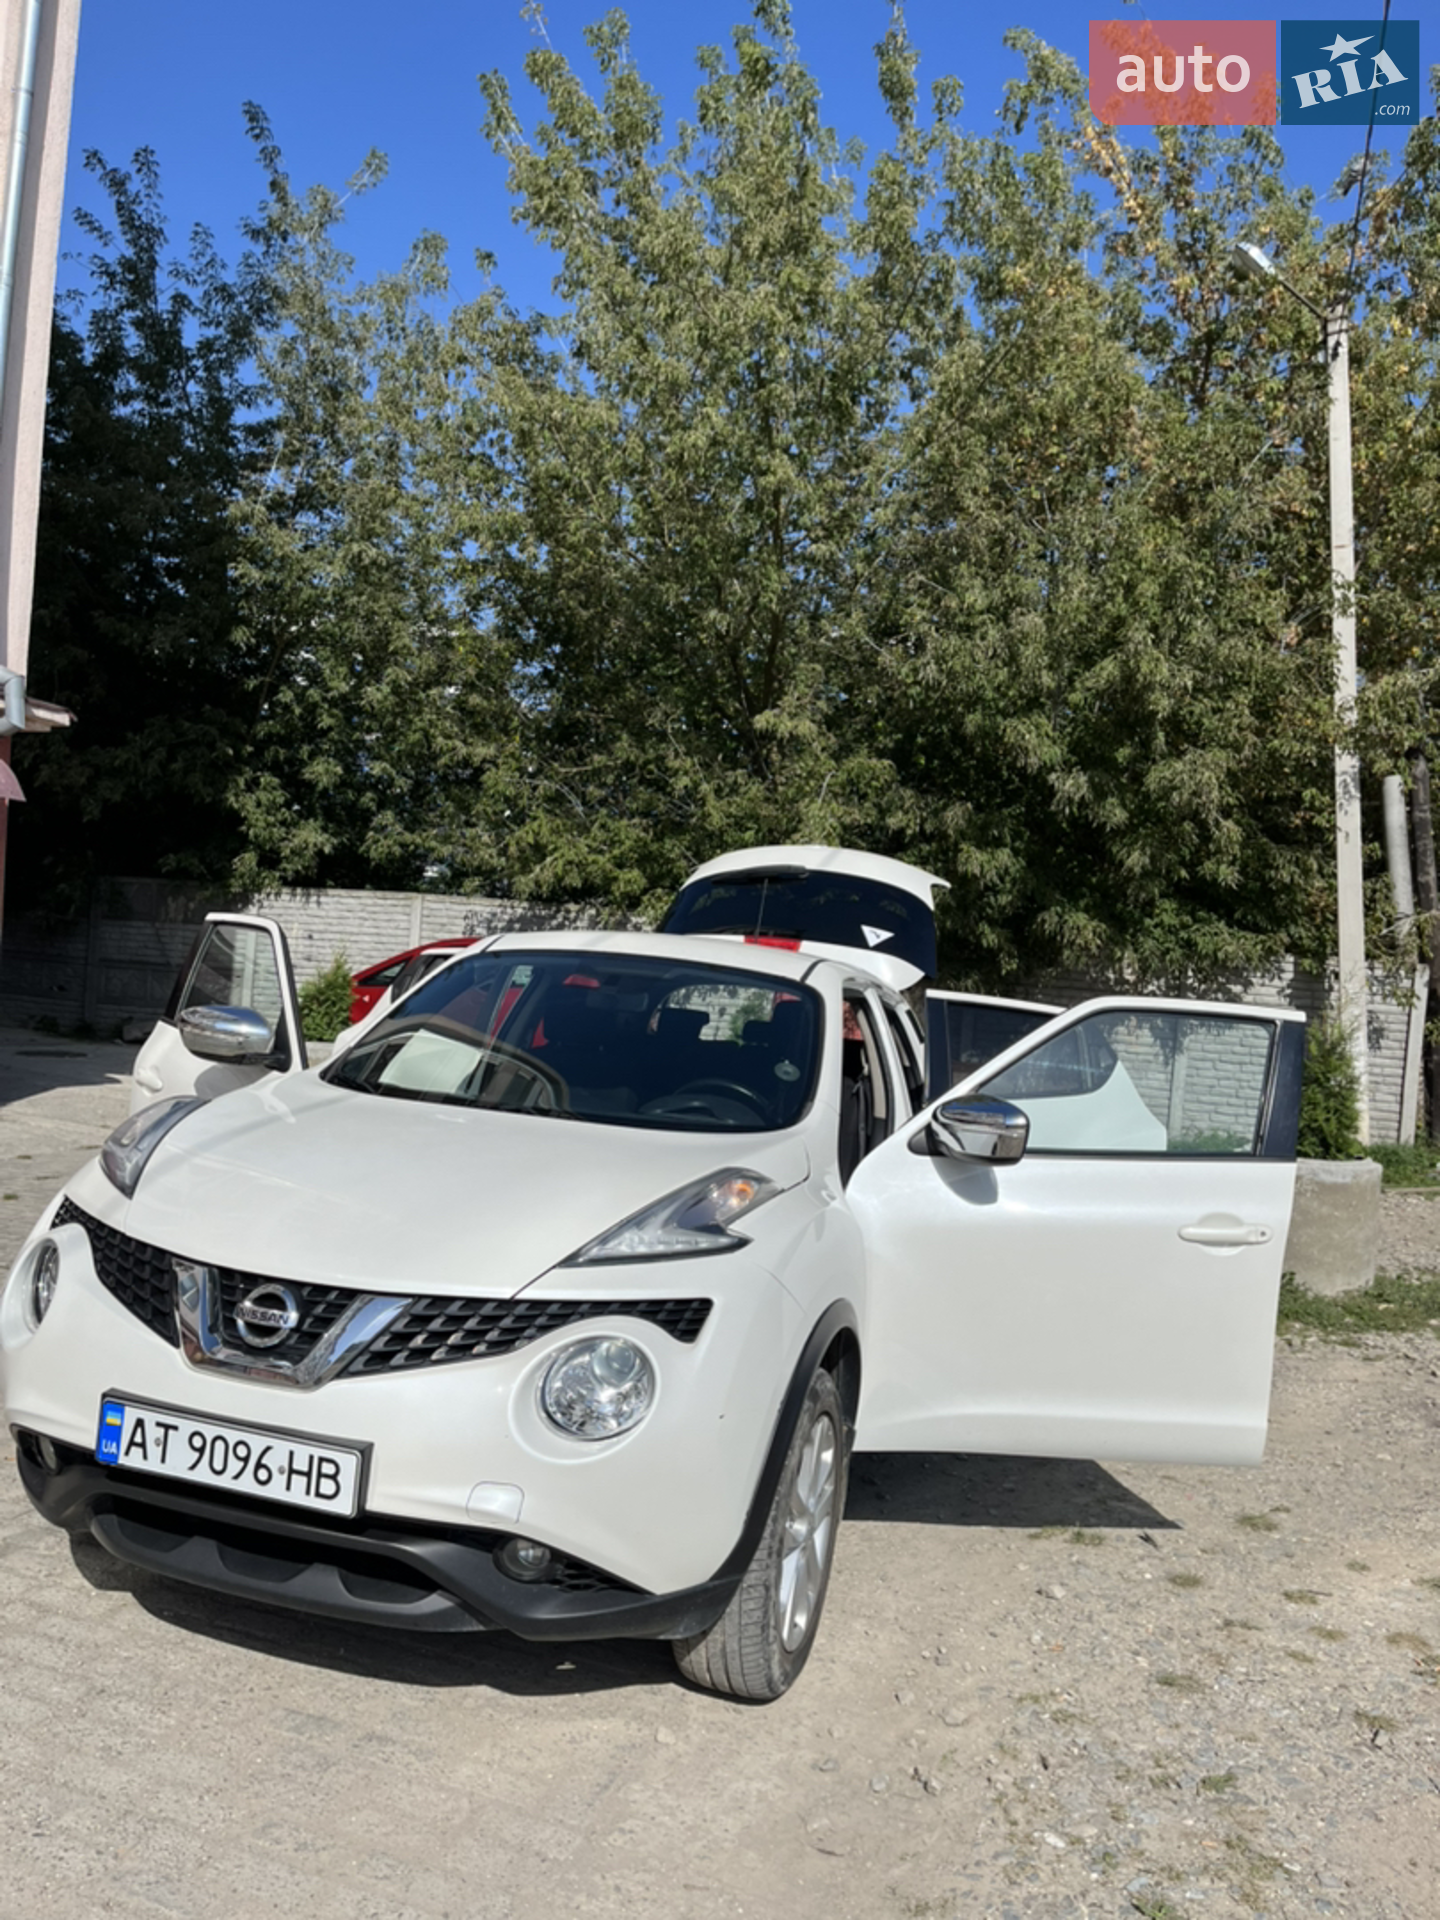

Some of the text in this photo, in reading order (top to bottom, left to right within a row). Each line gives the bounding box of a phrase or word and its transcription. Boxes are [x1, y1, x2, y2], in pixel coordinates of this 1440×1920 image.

[238, 1306, 290, 1326] NISSAN
[102, 1439, 119, 1455] UA
[124, 1417, 341, 1500] AT 9096 HB
